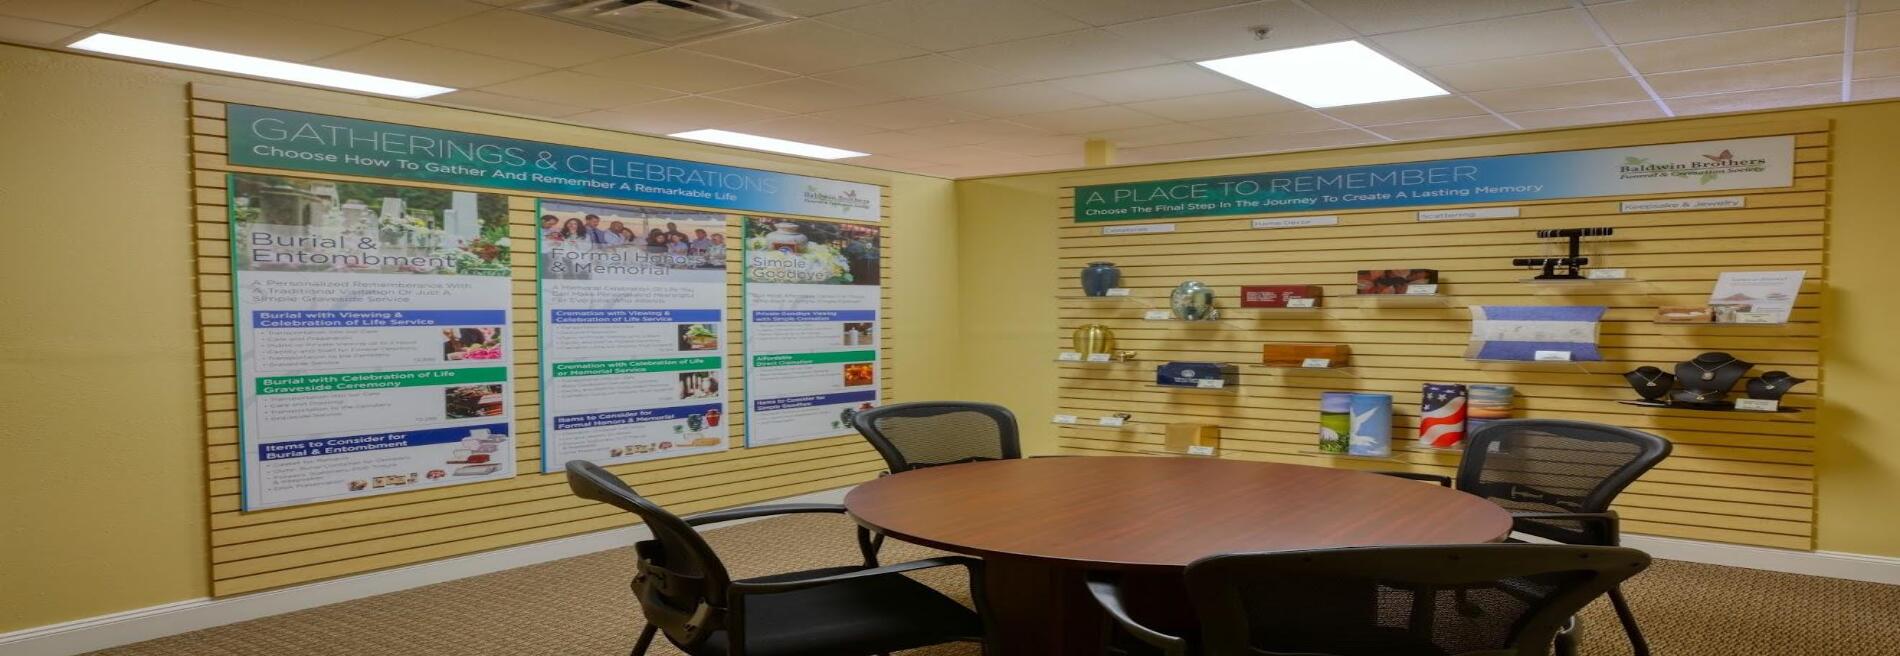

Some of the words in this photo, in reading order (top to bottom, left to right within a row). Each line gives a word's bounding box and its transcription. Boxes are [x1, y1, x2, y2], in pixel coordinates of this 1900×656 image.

[252, 118, 526, 167] GATHERINGS
[536, 150, 557, 170] &
[566, 155, 777, 194] CELEBRATIONS
[253, 145, 337, 162] Choose
[345, 154, 389, 168] How
[400, 159, 419, 170] To
[425, 162, 486, 177] Gather
[493, 169, 527, 181] And
[532, 173, 615, 189] Remember
[635, 184, 712, 199] Remarkable
[715, 192, 737, 201] Life
[1619, 163, 1686, 173] Baldwin
[1691, 158, 1766, 169] Brothers
[1086, 191, 1106, 205] A
[1114, 183, 1209, 203] PLACE
[1219, 180, 1259, 197] TO
[1271, 165, 1477, 193] REMEMBER
[1086, 208, 1127, 216] Choose
[1155, 204, 1184, 212] Final
[1188, 203, 1215, 211] Step
[1263, 196, 1318, 207] Journey
[1321, 195, 1338, 203] To
[1342, 191, 1391, 202] Create
[1396, 190, 1408, 199] A
[1412, 188, 1470, 199] Lasting
[1475, 184, 1544, 194] Memory
[252, 232, 345, 249] Burial
[357, 237, 377, 250] &
[252, 248, 457, 268] Entombment
[551, 248, 628, 262] Formal
[753, 257, 806, 268] Simple
[551, 261, 565, 273] &
[575, 262, 670, 276] Memorial
[260, 319, 342, 327] Celebration
[339, 311, 391, 320] Viewing
[263, 378, 304, 386] Burial
[341, 373, 414, 382] Celebration
[263, 384, 332, 394] Graveside
[336, 381, 401, 391] Ceremony
[599, 412, 638, 420] Consider
[558, 422, 592, 430] Formal
[265, 443, 306, 452] Items
[327, 435, 385, 446] Consider
[265, 450, 307, 460] Burial
[311, 447, 320, 455] &
[324, 440, 408, 454] Entombment
